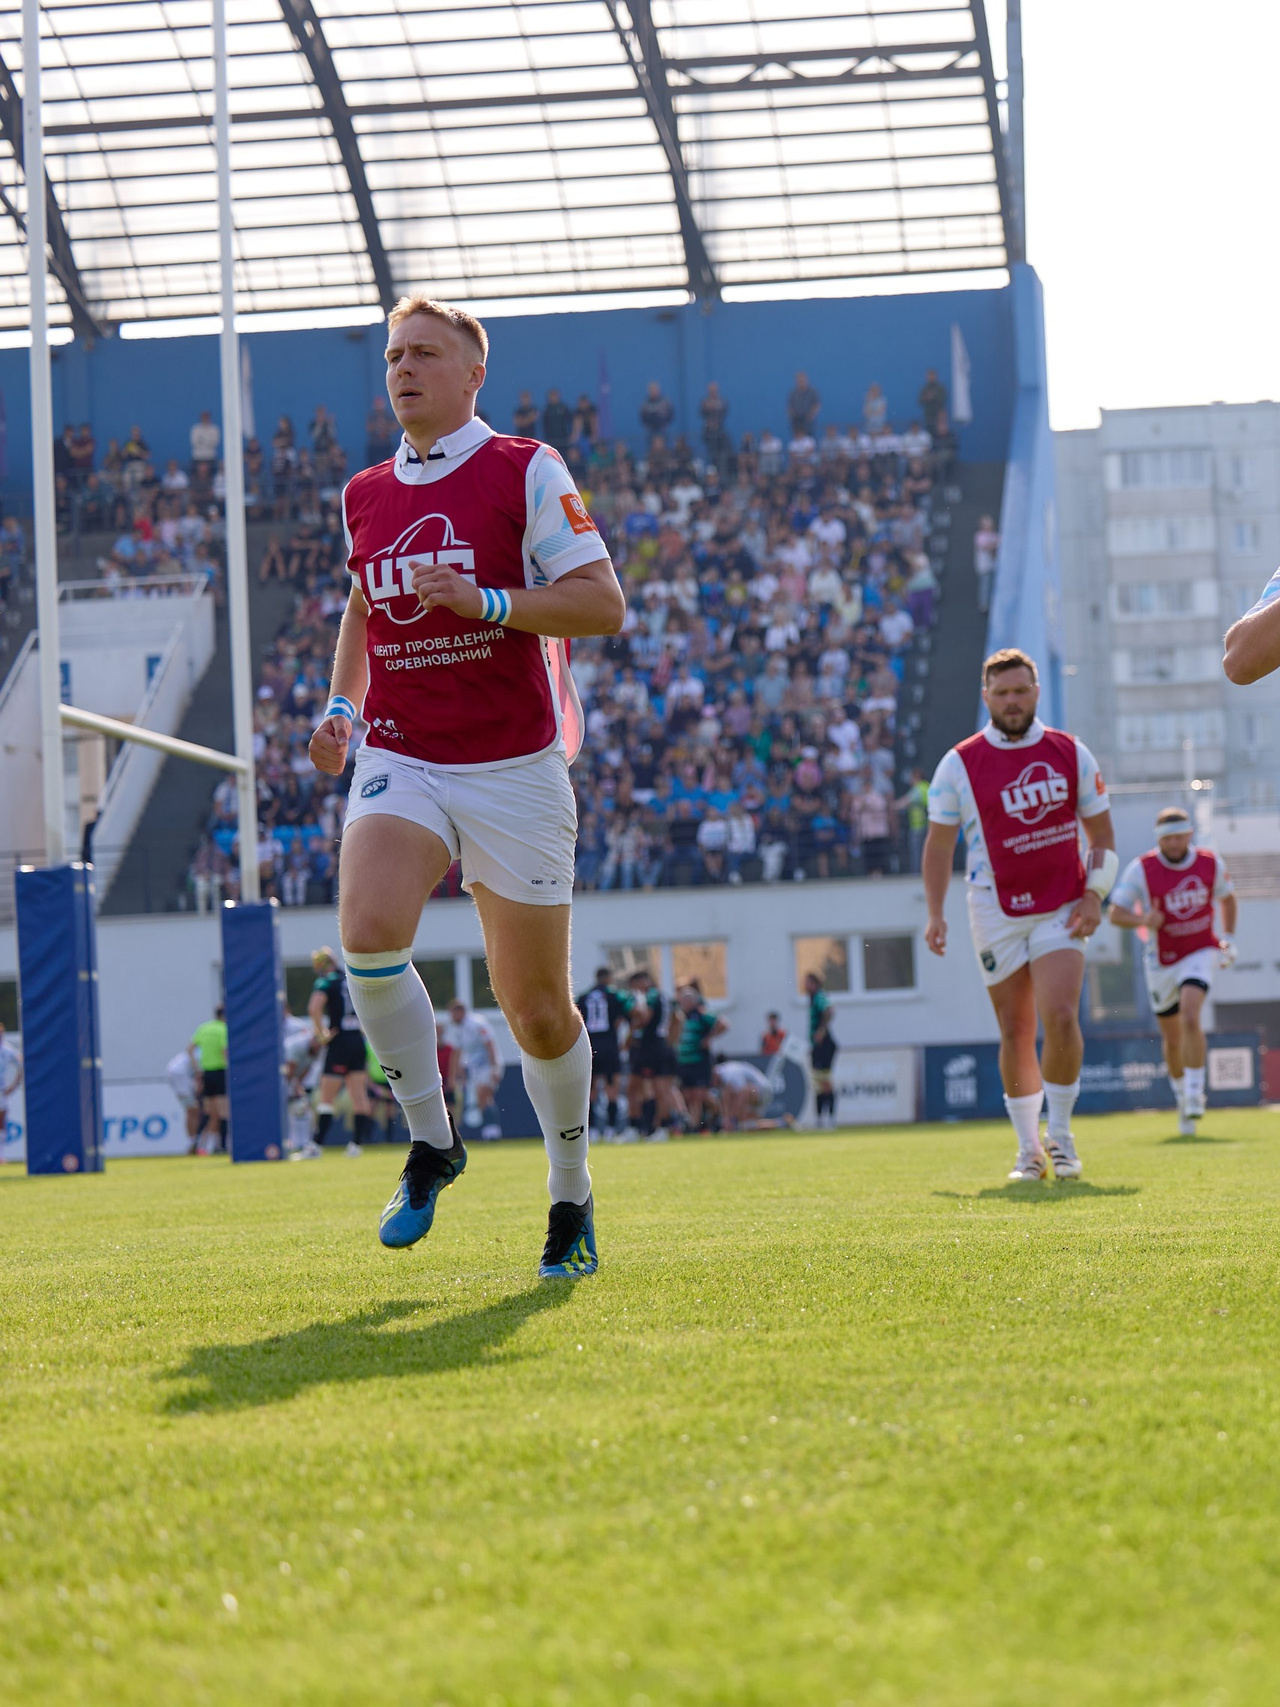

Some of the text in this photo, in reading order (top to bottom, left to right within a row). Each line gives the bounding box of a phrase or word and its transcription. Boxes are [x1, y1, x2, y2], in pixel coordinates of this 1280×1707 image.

[405, 627, 505, 654] ПРОВЕДЕНИЯ
[385, 644, 492, 671] СОРЕВНОВАНИЙ
[1001, 777, 1069, 813] ЦПС
[1002, 832, 1030, 849] ЦЕНТР
